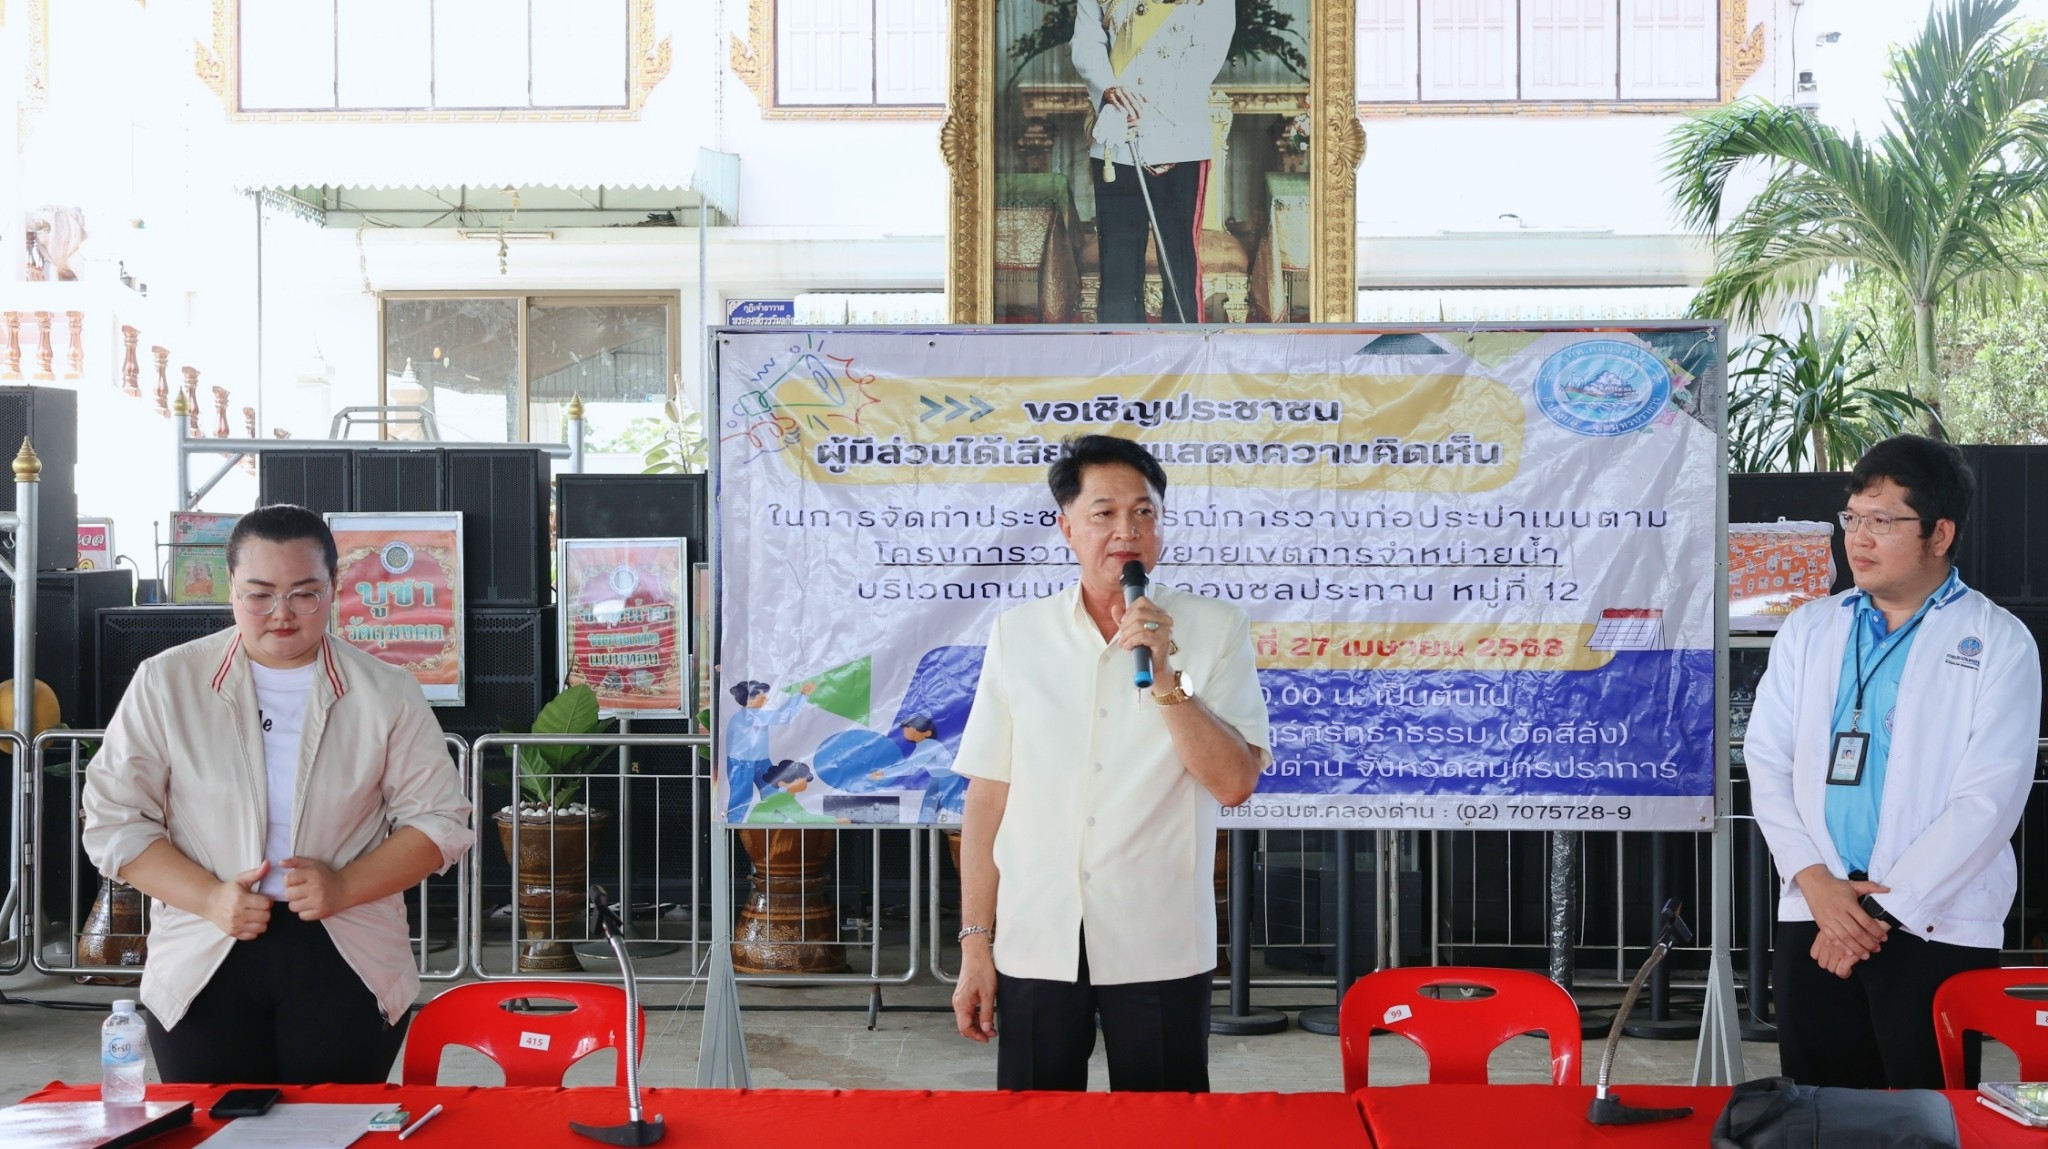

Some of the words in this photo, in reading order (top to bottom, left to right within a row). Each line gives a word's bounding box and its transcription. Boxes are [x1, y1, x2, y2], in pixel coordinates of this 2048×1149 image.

[1024, 396, 1339, 428] ขอเชิญประชาชน
[355, 580, 434, 618] บูชา
[1453, 575, 1527, 607] หมู่ที่
[1545, 580, 1579, 601] 12
[346, 617, 444, 648] วัตถุมงคล
[1291, 637, 1330, 656] 27
[1342, 638, 1464, 657] เมษายน
[1477, 637, 1564, 657] 2568
[1376, 682, 1509, 707] เป็นต้นไป
[1500, 721, 1629, 746] (วัดสีล้ง)
[1356, 754, 1678, 786] จังหวัดสมุทรปราการ
[1456, 804, 1499, 822] (02)
[1507, 805, 1632, 820] 7075728-9
[1390, 1009, 1402, 1019] 99
[526, 1037, 544, 1047] 415
